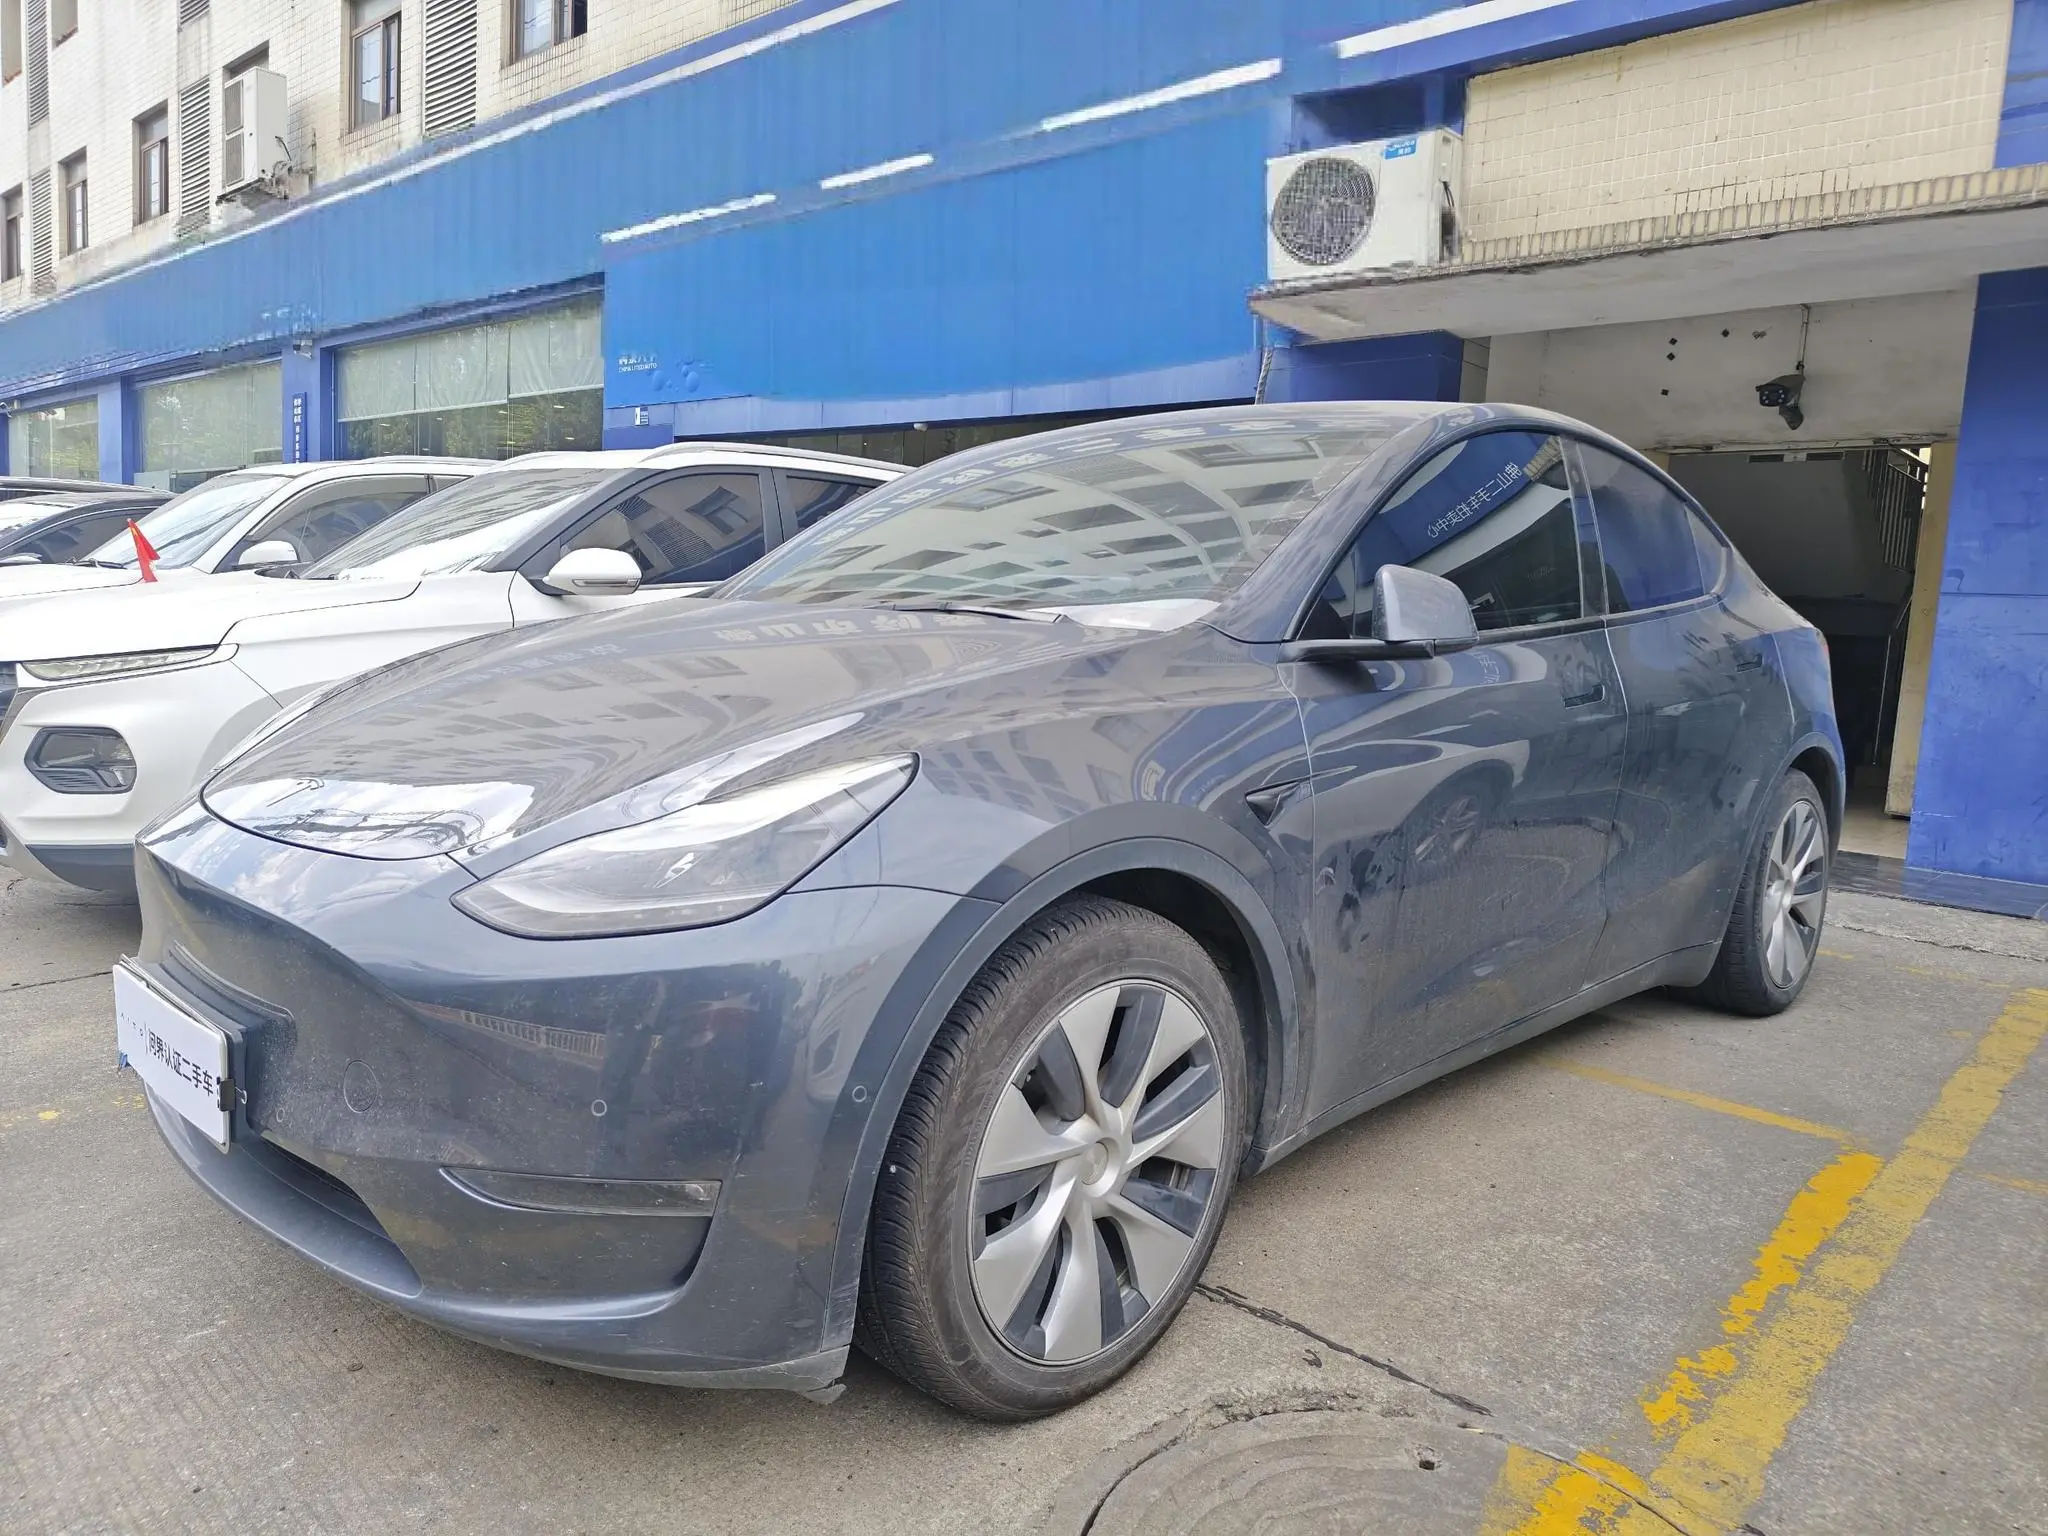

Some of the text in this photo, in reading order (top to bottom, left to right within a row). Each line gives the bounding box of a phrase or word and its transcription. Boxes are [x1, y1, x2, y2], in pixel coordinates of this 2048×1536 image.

[148, 1029, 214, 1097] 问界认证二手车
